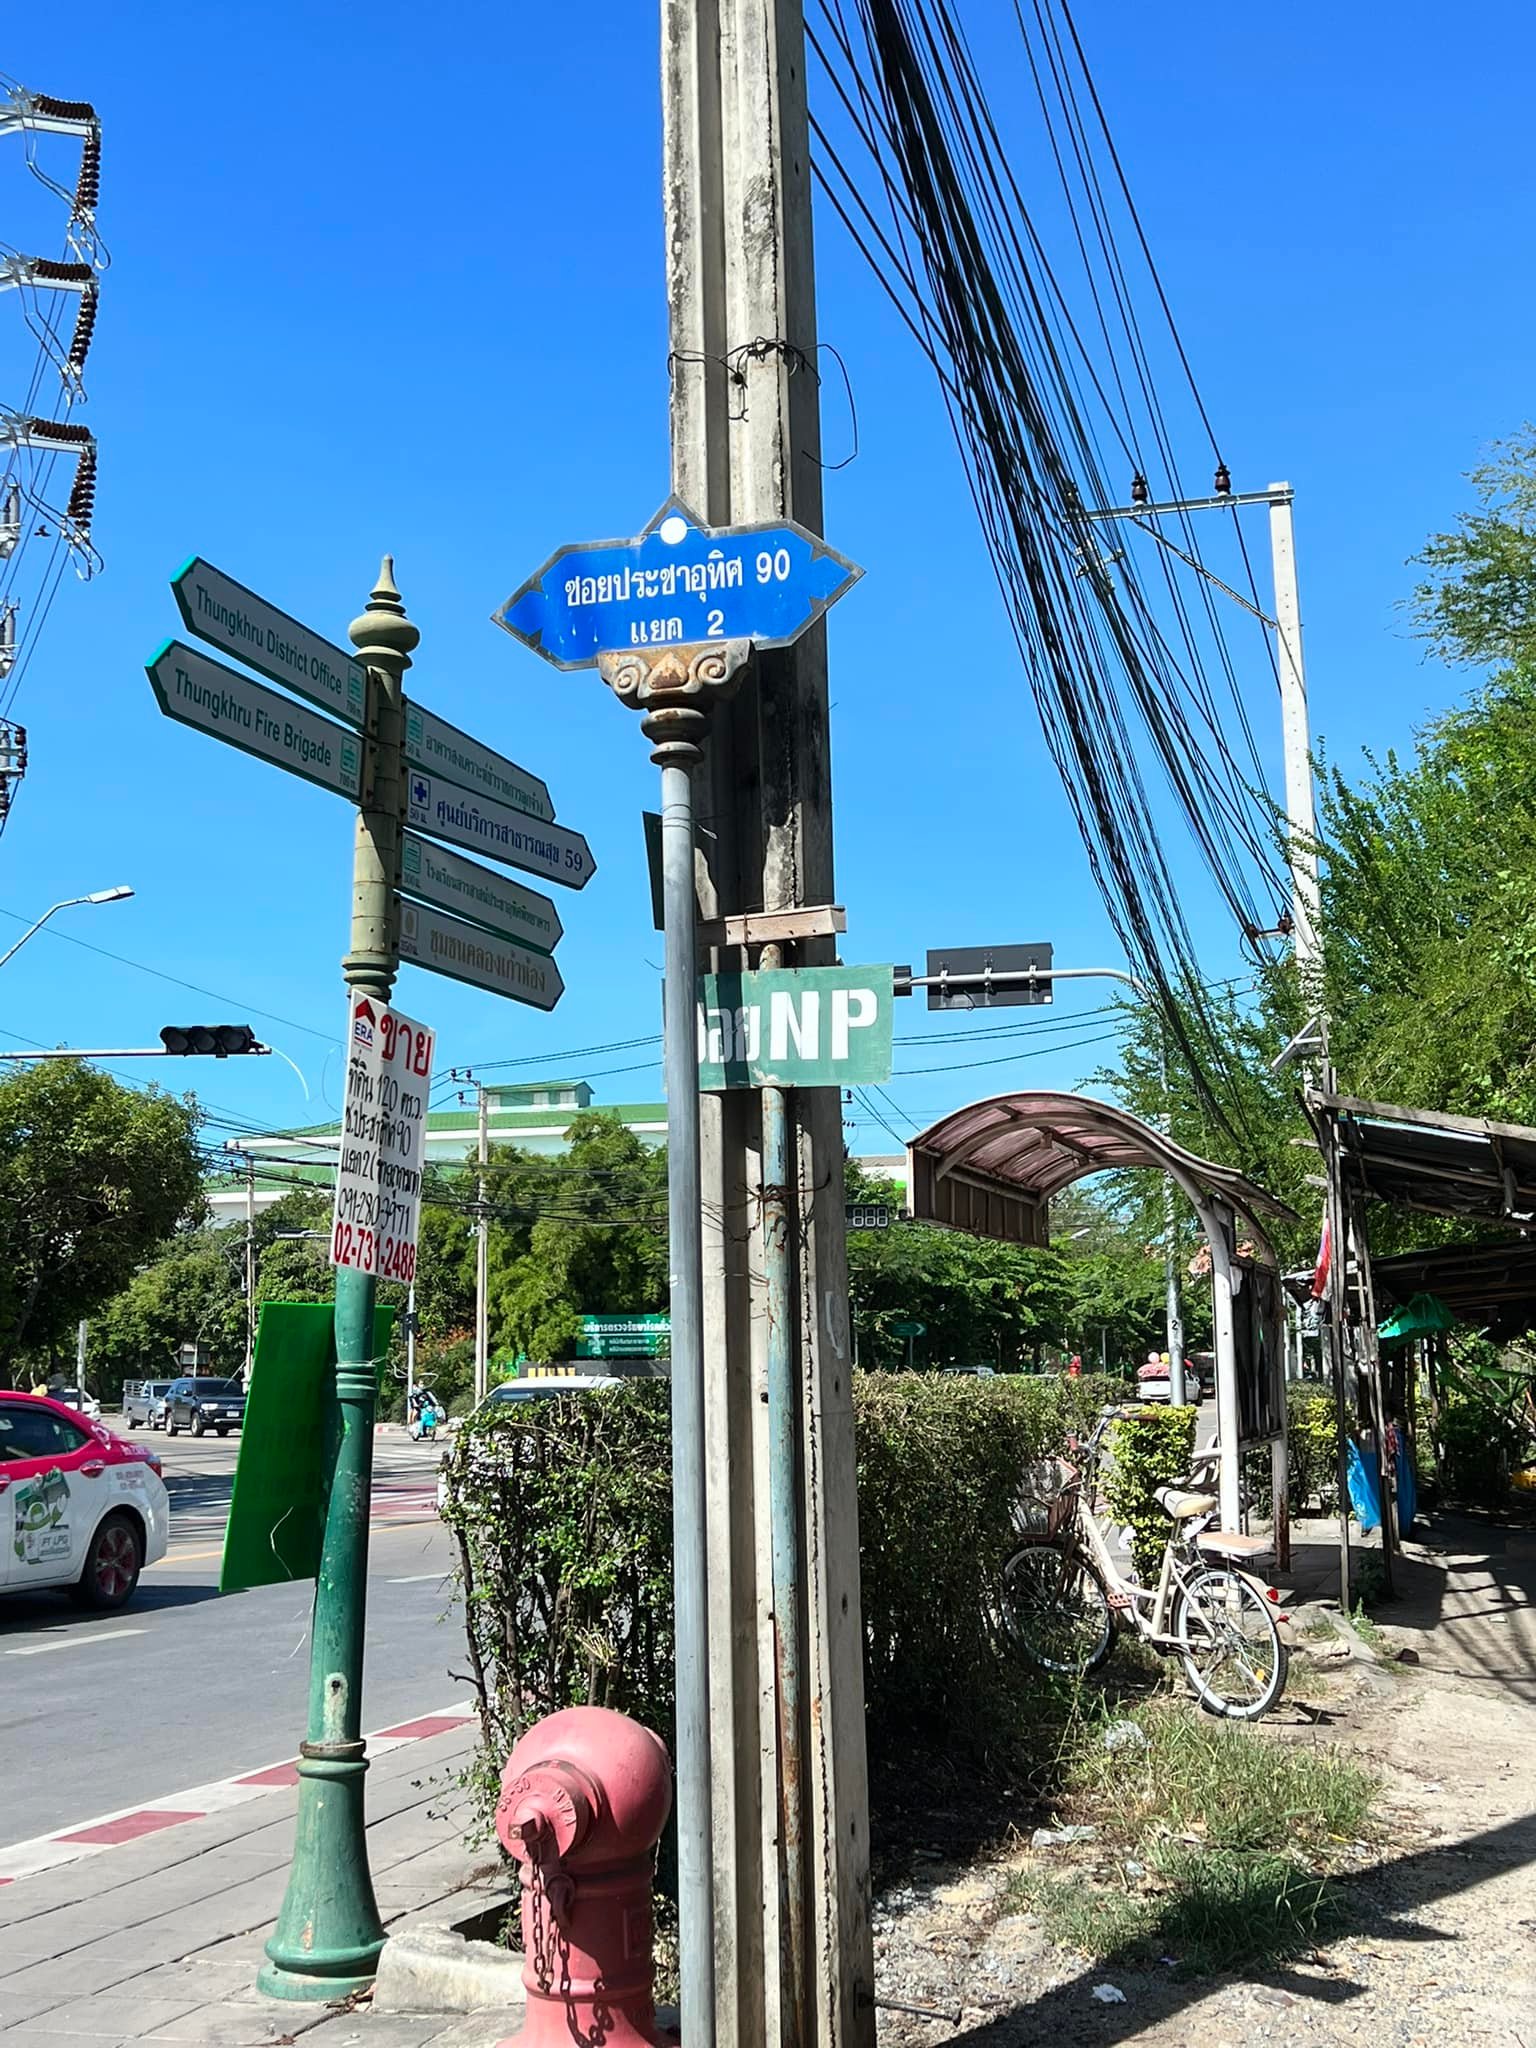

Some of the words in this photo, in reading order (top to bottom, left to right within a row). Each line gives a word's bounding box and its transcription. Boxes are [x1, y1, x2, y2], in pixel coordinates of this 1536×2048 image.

[565, 548, 743, 607] ซอยประชาอุทิศ
[756, 548, 791, 584] 90
[196, 584, 264, 649] Thungkhru
[267, 629, 309, 676] District
[311, 657, 342, 695] Office
[631, 615, 683, 644] แยก
[707, 609, 724, 637] 2
[175, 668, 252, 729] Thungkhru
[255, 710, 281, 742] Fire
[284, 723, 332, 767] Brigade
[436, 801, 560, 867] ศูนย์บริการสาธารณสุข
[565, 849, 583, 872] 59
[354, 1022, 373, 1042] ERA
[380, 1014, 431, 1077] ขาย
[377, 1073, 398, 1112] 120
[334, 1221, 415, 1283] 02-731-2488
[1171, 1319, 1178, 1331] 2
